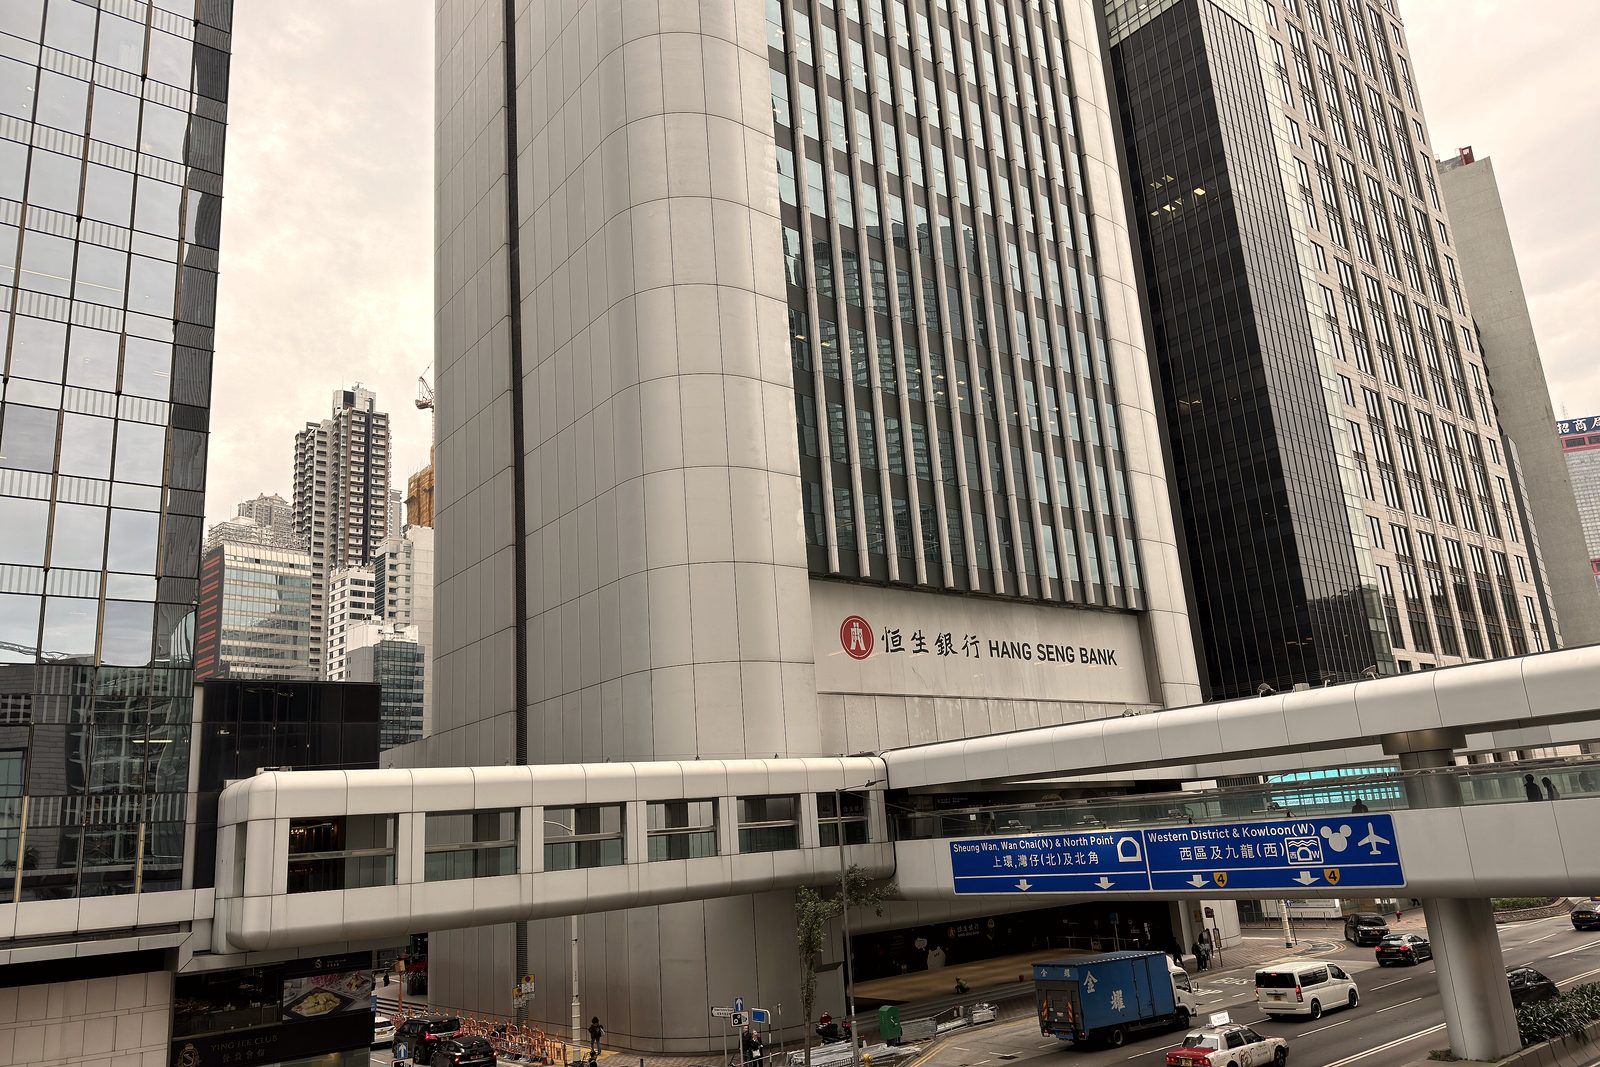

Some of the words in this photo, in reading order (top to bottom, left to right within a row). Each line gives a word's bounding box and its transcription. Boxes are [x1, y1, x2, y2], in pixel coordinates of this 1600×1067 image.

[881, 625, 980, 659] 恒生銀行
[988, 639, 1032, 660] HANG
[1036, 644, 1075, 663] SENG
[1080, 647, 1118, 666] BANK
[1147, 831, 1188, 842] Western
[1190, 828, 1230, 840] District
[1232, 828, 1239, 837] &
[1241, 823, 1315, 837] Kowloon(W)
[953, 843, 980, 853] Sheung
[1000, 841, 1018, 850] Wan
[1019, 839, 1053, 850] Chai(N)
[1055, 838, 1061, 847] &
[1063, 836, 1088, 847] North
[1089, 835, 1114, 845] Point
[1179, 842, 1285, 860] 西區及九龍(西)
[1217, 873, 1226, 884] 4
[1328, 870, 1337, 882] 4
